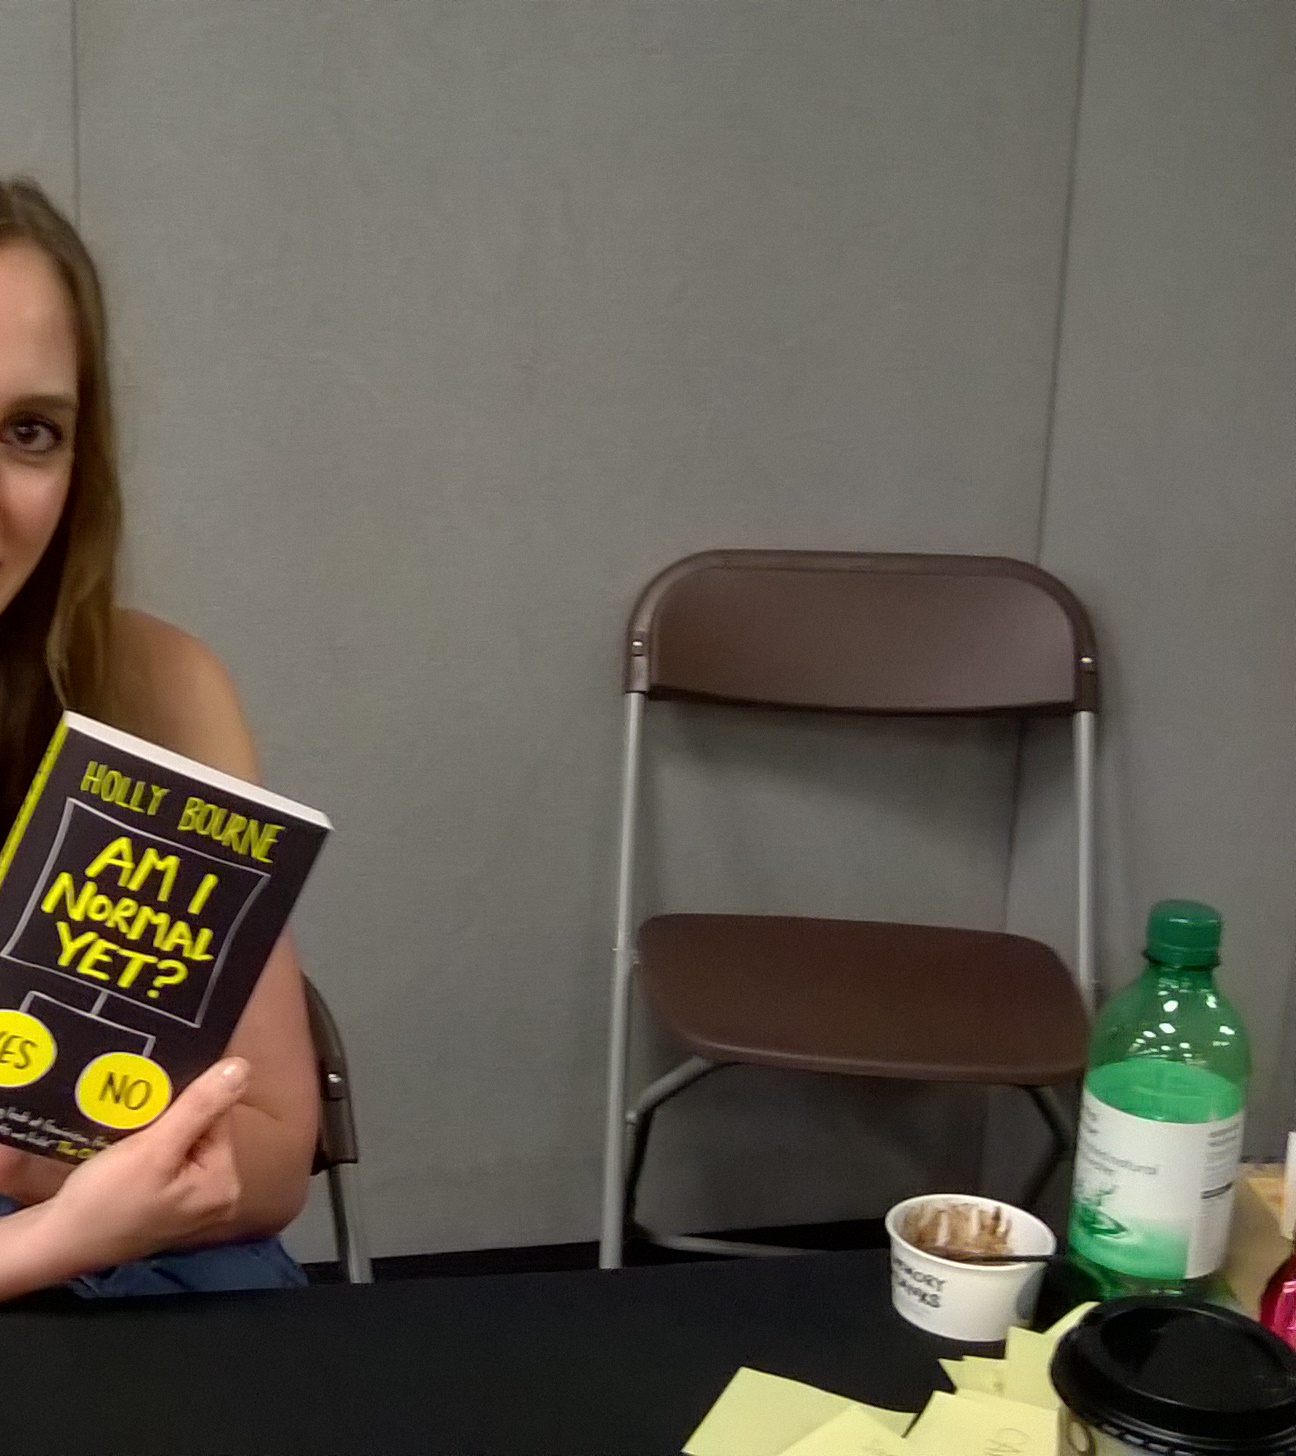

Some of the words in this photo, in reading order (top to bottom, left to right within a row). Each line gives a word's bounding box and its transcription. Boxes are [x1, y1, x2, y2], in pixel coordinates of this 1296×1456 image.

[80, 760, 170, 816] HOLLY
[177, 796, 286, 863] BOURNE
[85, 836, 181, 902] AM
[188, 873, 218, 915] I
[41, 872, 214, 961] NORMAL
[56, 921, 188, 999] YET?
[98, 1072, 152, 1111] NO
